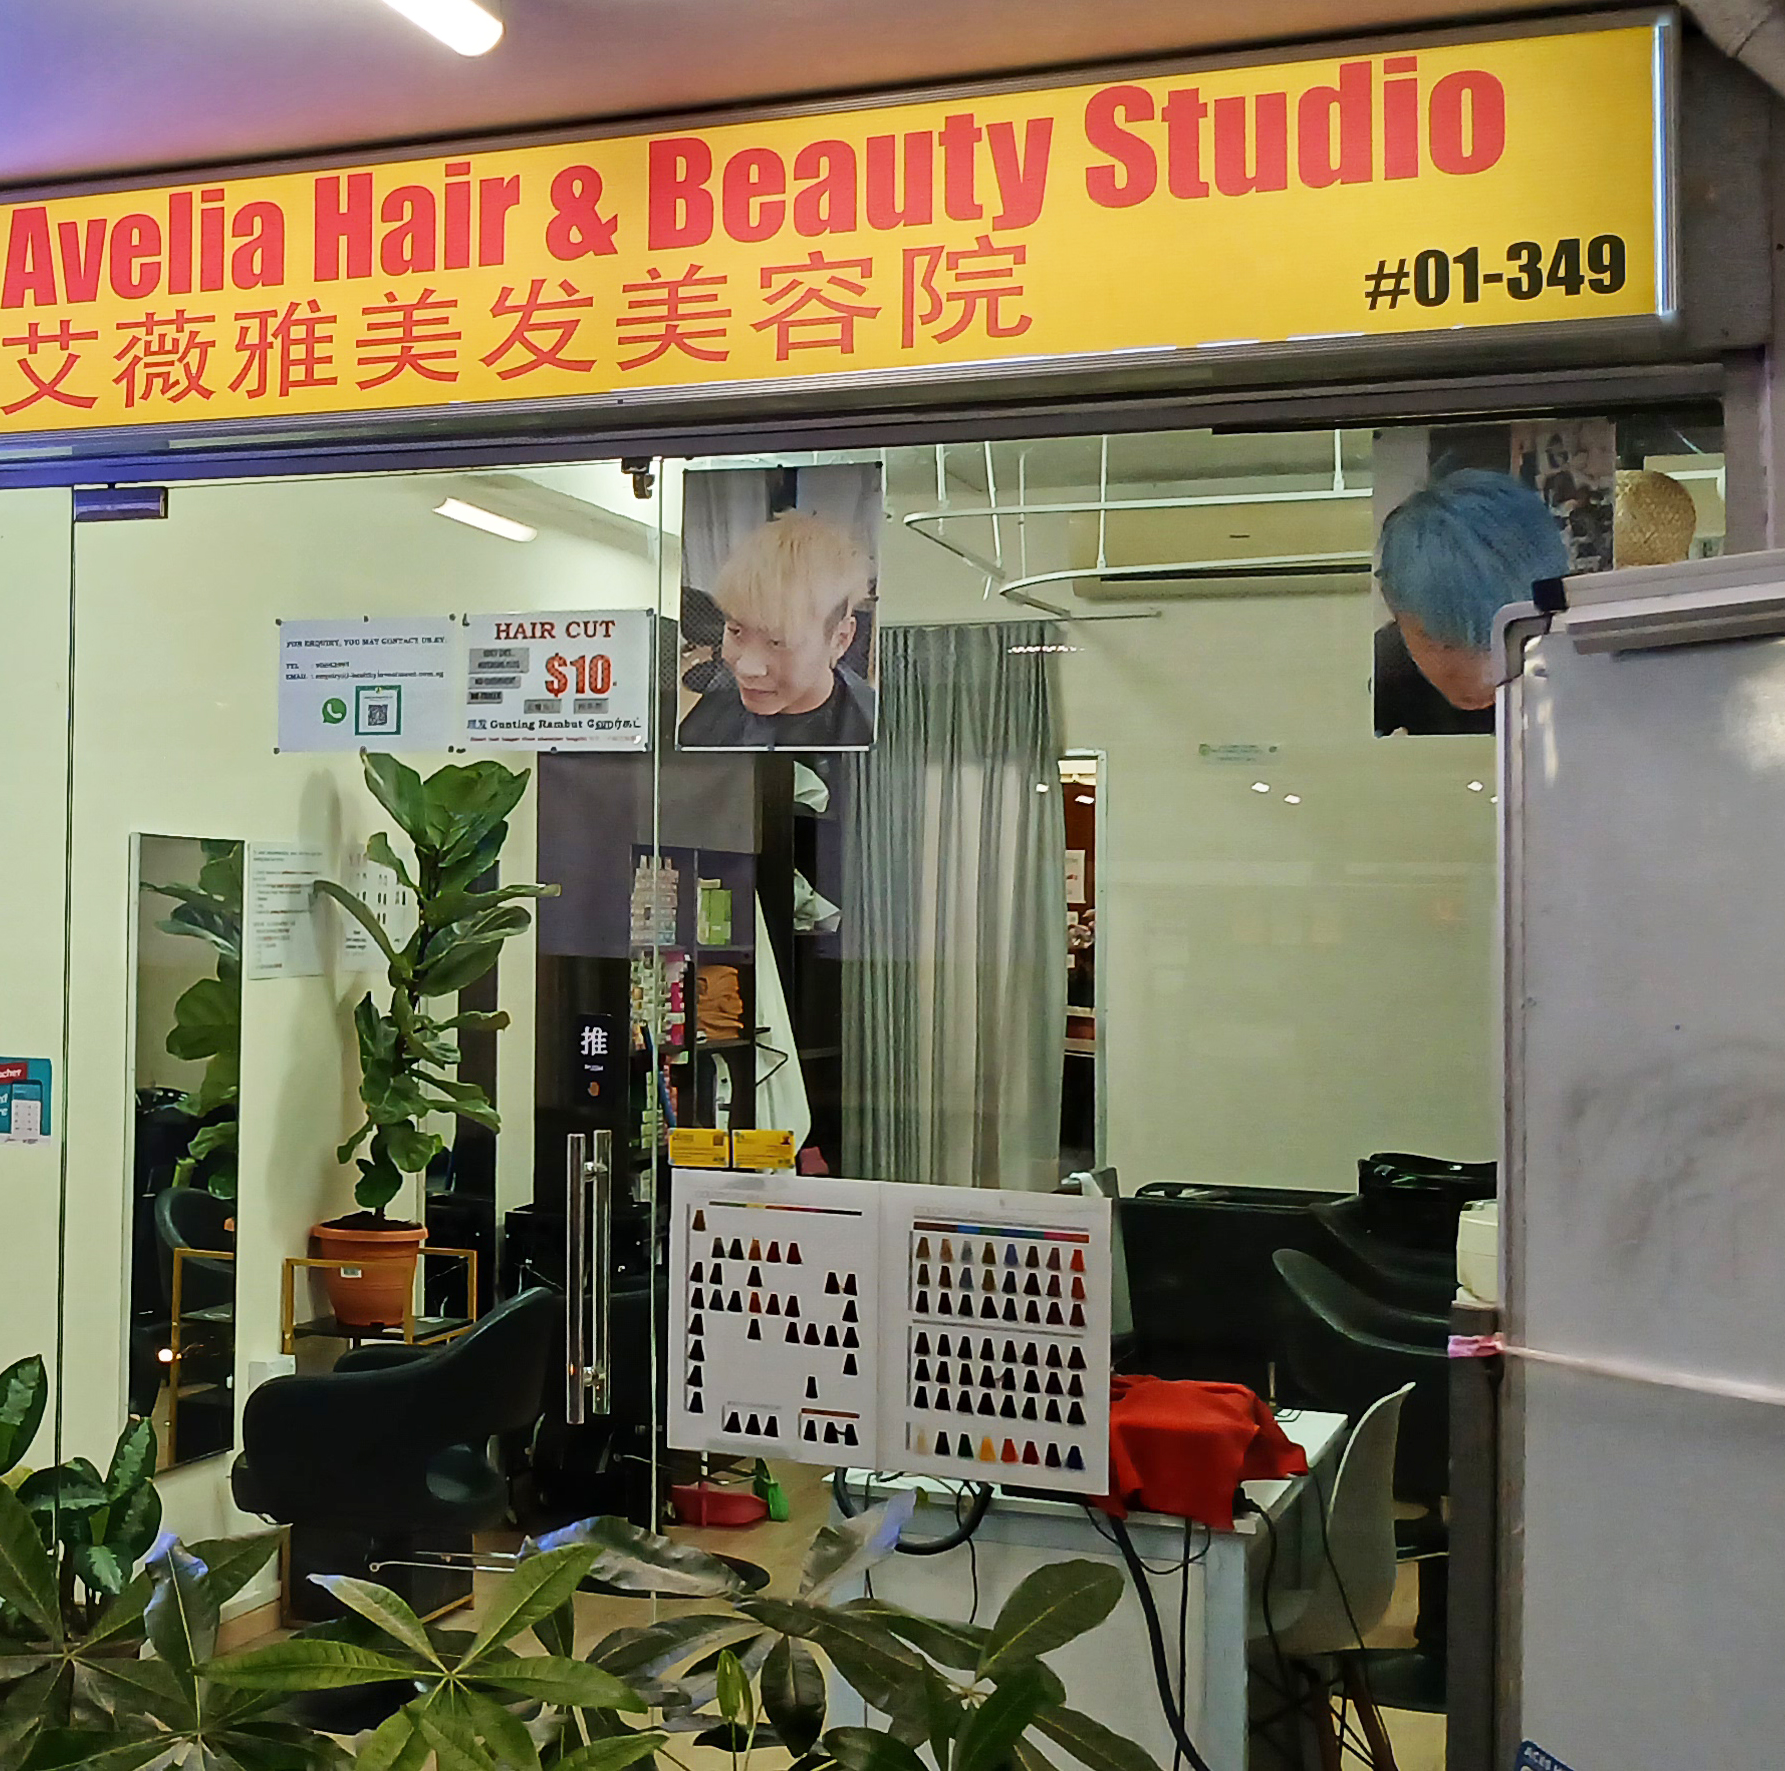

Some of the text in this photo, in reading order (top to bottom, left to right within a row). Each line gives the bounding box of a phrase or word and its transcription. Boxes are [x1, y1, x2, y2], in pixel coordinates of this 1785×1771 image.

[1, 57, 1506, 308] Avelia Hair & Beauty Studio
[1364, 235, 1626, 312] #01-349
[0, 235, 1033, 415] 艾薇雅美发美容院
[494, 620, 615, 640] HAIR CUT
[544, 653, 611, 697] $10
[580, 1026, 608, 1056] 推
